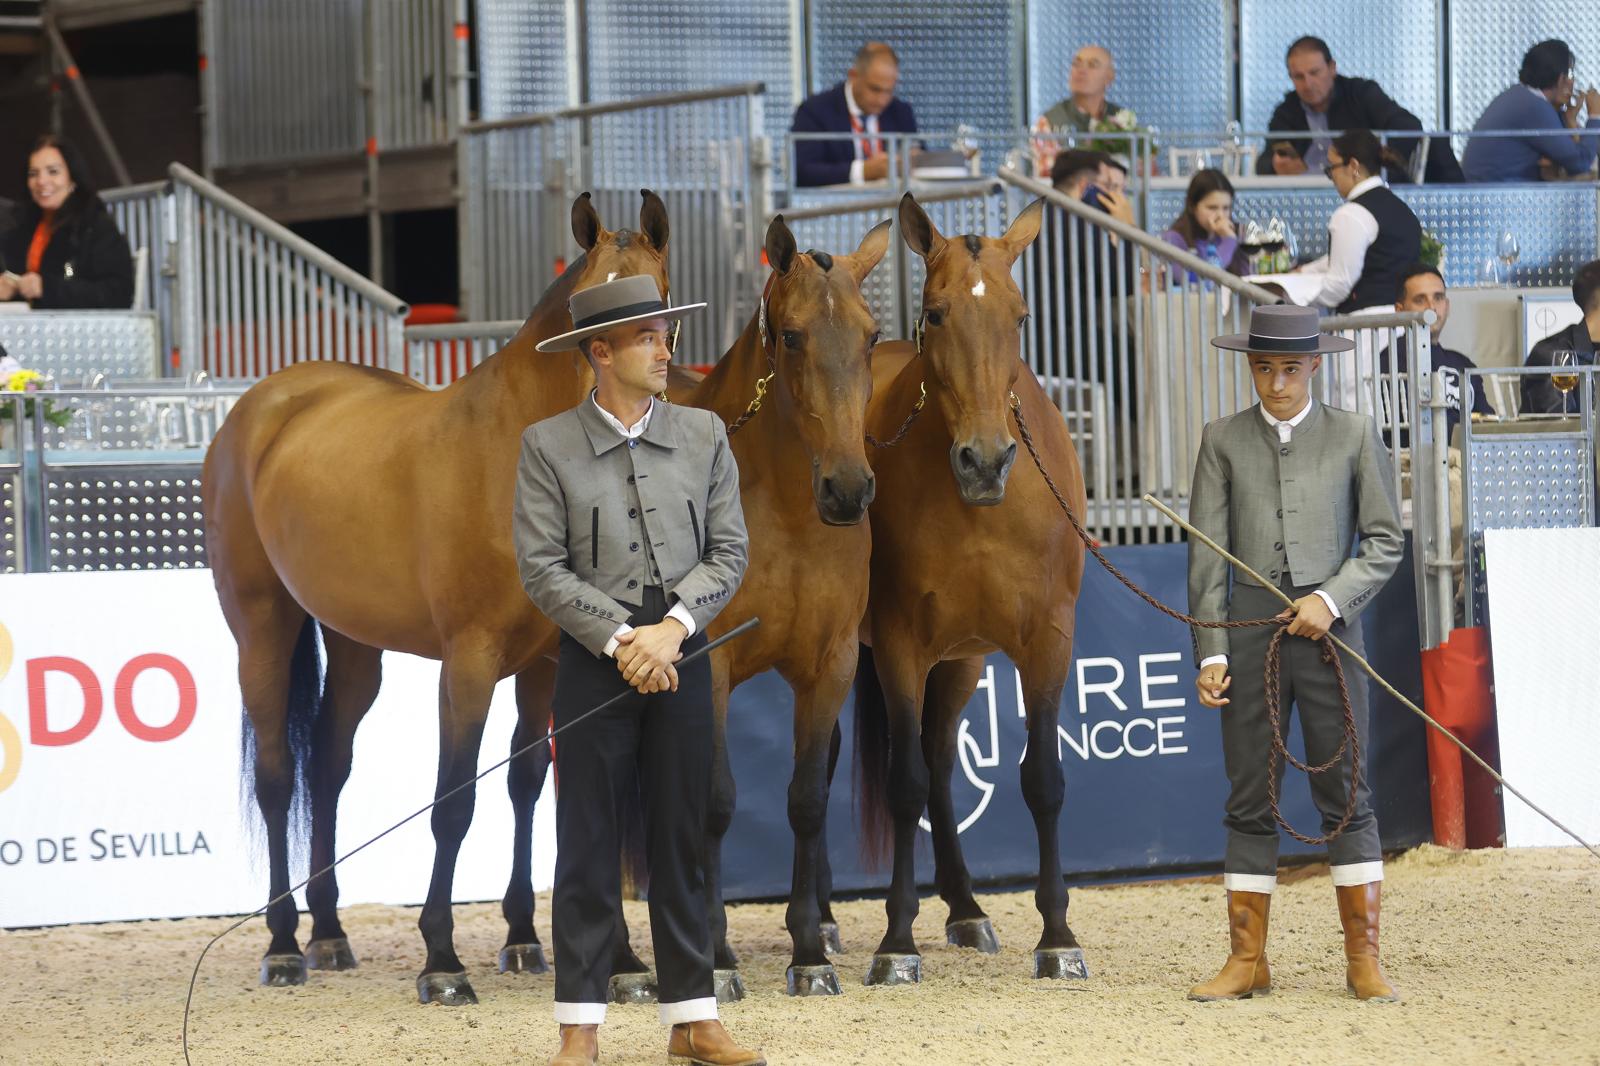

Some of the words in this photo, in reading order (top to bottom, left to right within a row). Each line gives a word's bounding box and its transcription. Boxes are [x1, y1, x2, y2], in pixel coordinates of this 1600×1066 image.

[1015, 652, 1186, 718] RE
[1019, 716, 1189, 764] NCCE
[36, 837, 77, 864] DE
